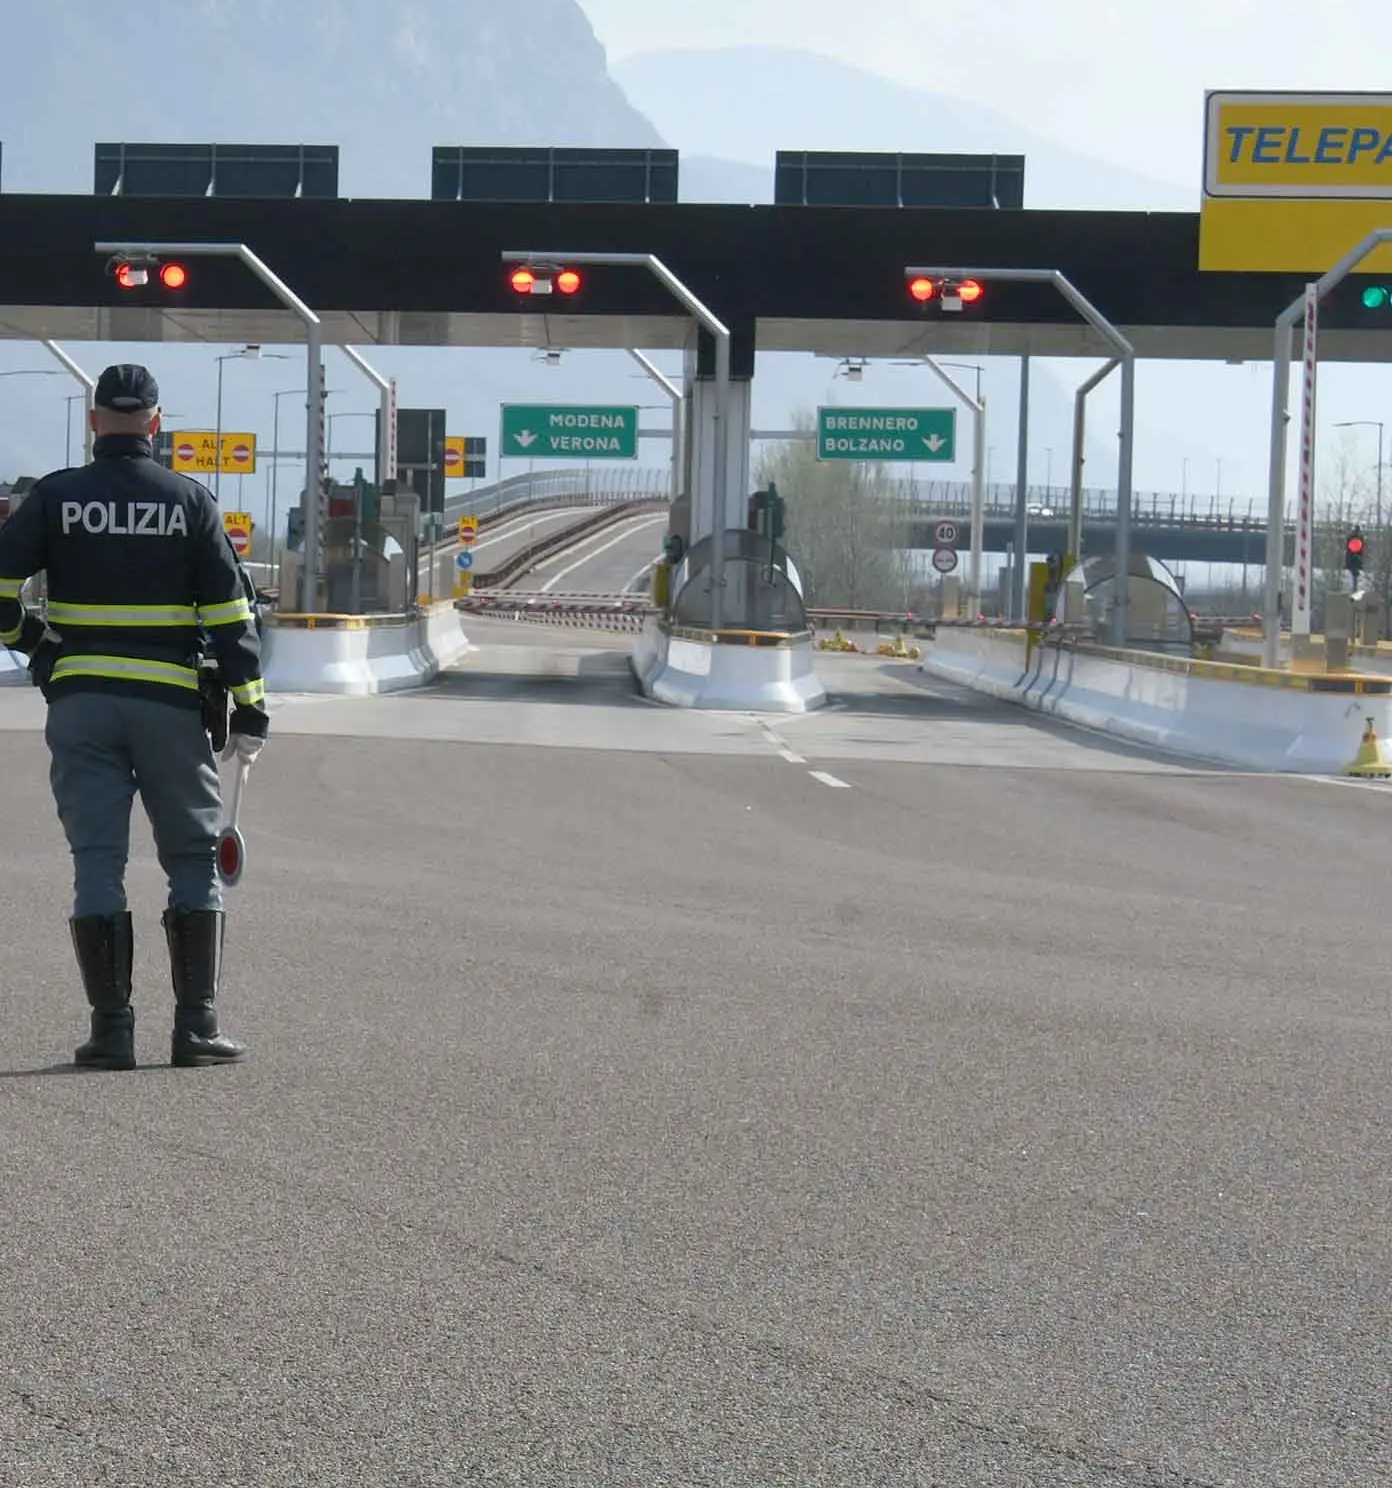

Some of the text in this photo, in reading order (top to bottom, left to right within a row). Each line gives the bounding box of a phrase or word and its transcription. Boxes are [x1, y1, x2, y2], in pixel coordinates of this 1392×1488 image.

[549, 414, 625, 429] MODENA
[825, 416, 918, 431] BRENNERO
[202, 439, 226, 450] ALT
[550, 435, 621, 450] VERONA
[825, 437, 905, 451] BOLZANO
[196, 456, 230, 467] HAT
[61, 501, 188, 537] POLIZIA
[225, 515, 248, 525] ALT
[938, 526, 954, 539] 40
